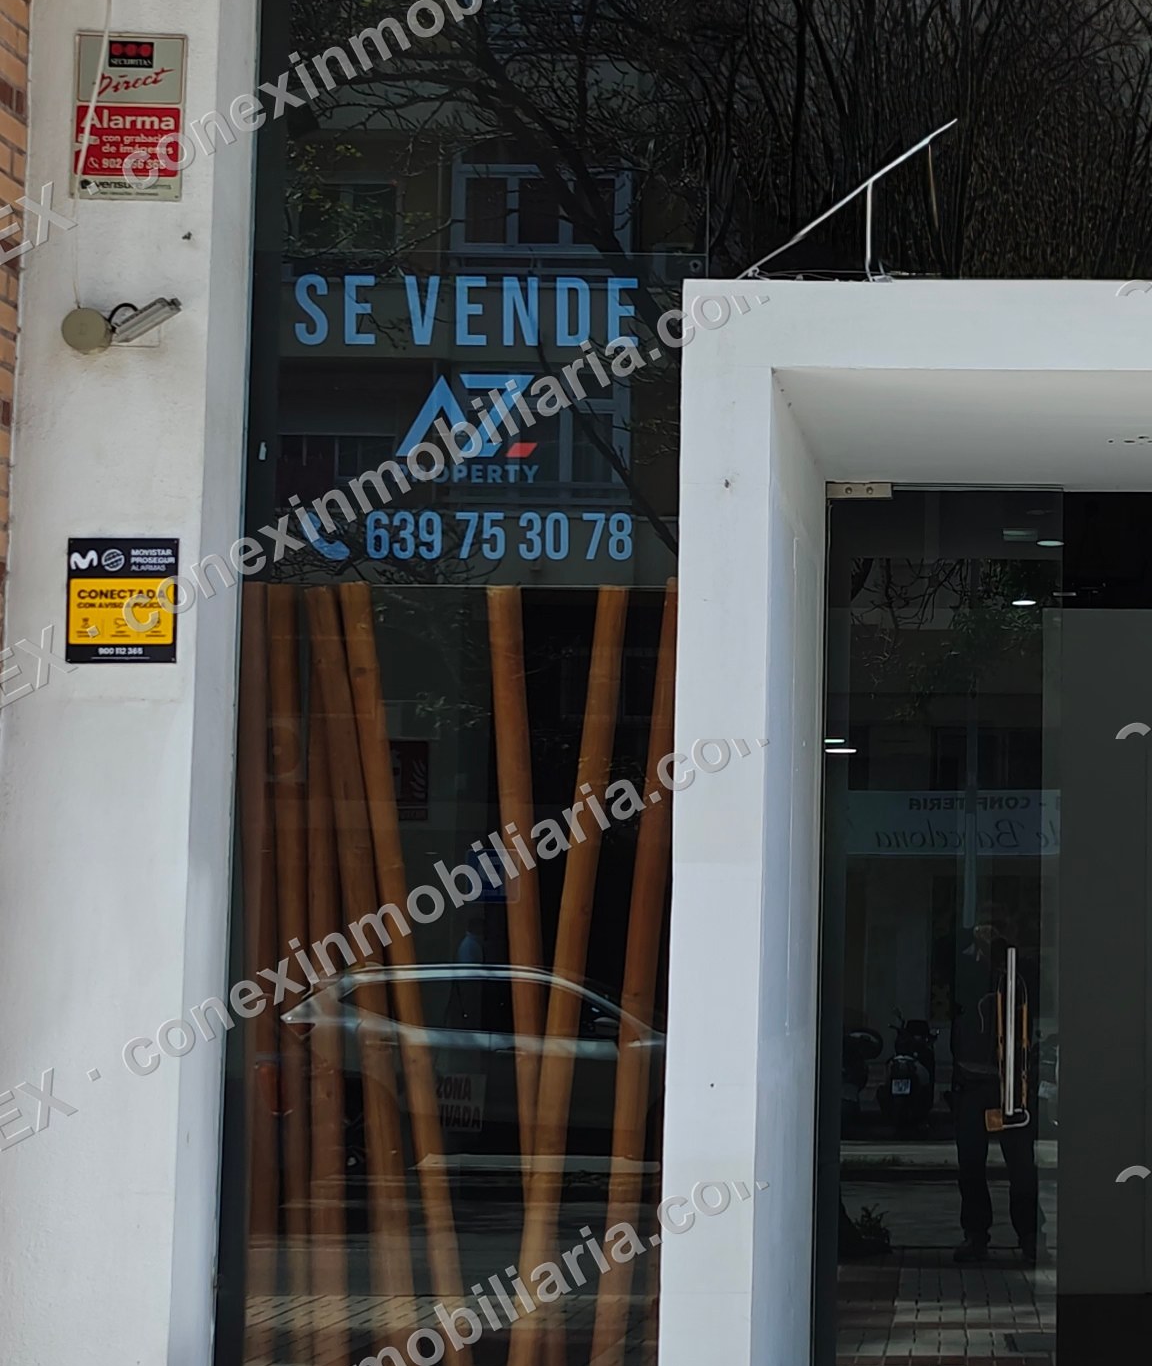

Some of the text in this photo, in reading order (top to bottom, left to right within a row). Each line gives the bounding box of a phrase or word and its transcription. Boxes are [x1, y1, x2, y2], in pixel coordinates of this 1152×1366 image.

[81, 110, 176, 130] Alarma
[102, 135, 121, 143] con
[101, 143, 117, 153] de
[294, 273, 640, 347] SE VENDE
[366, 510, 633, 562] 639 75 30 78
[77, 589, 166, 600] CONECTADA
